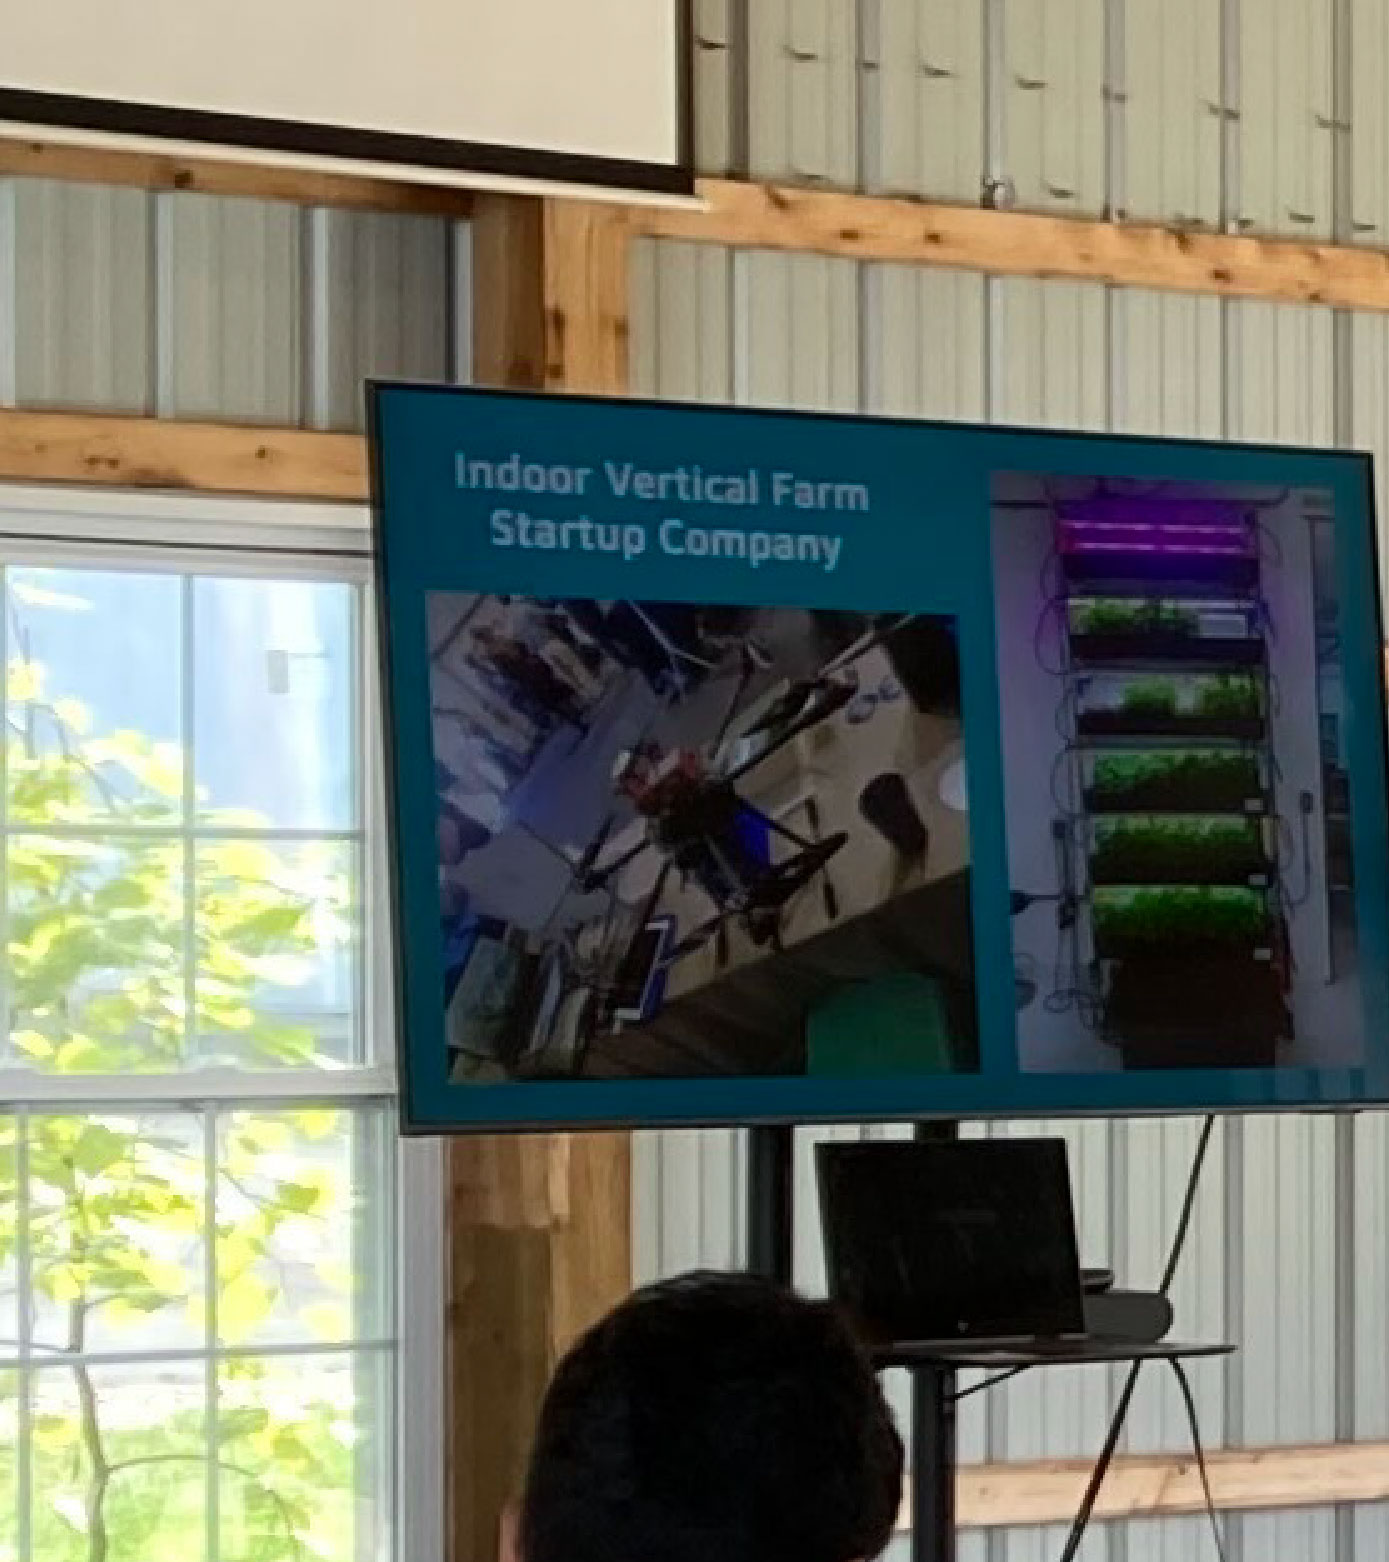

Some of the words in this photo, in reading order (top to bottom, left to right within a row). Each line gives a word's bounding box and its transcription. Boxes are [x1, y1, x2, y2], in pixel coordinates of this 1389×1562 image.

[454, 450, 594, 495] Indoor
[603, 459, 760, 505] Vertical
[771, 472, 870, 512] Farm
[490, 508, 647, 561] Startup
[659, 518, 843, 573] Company
